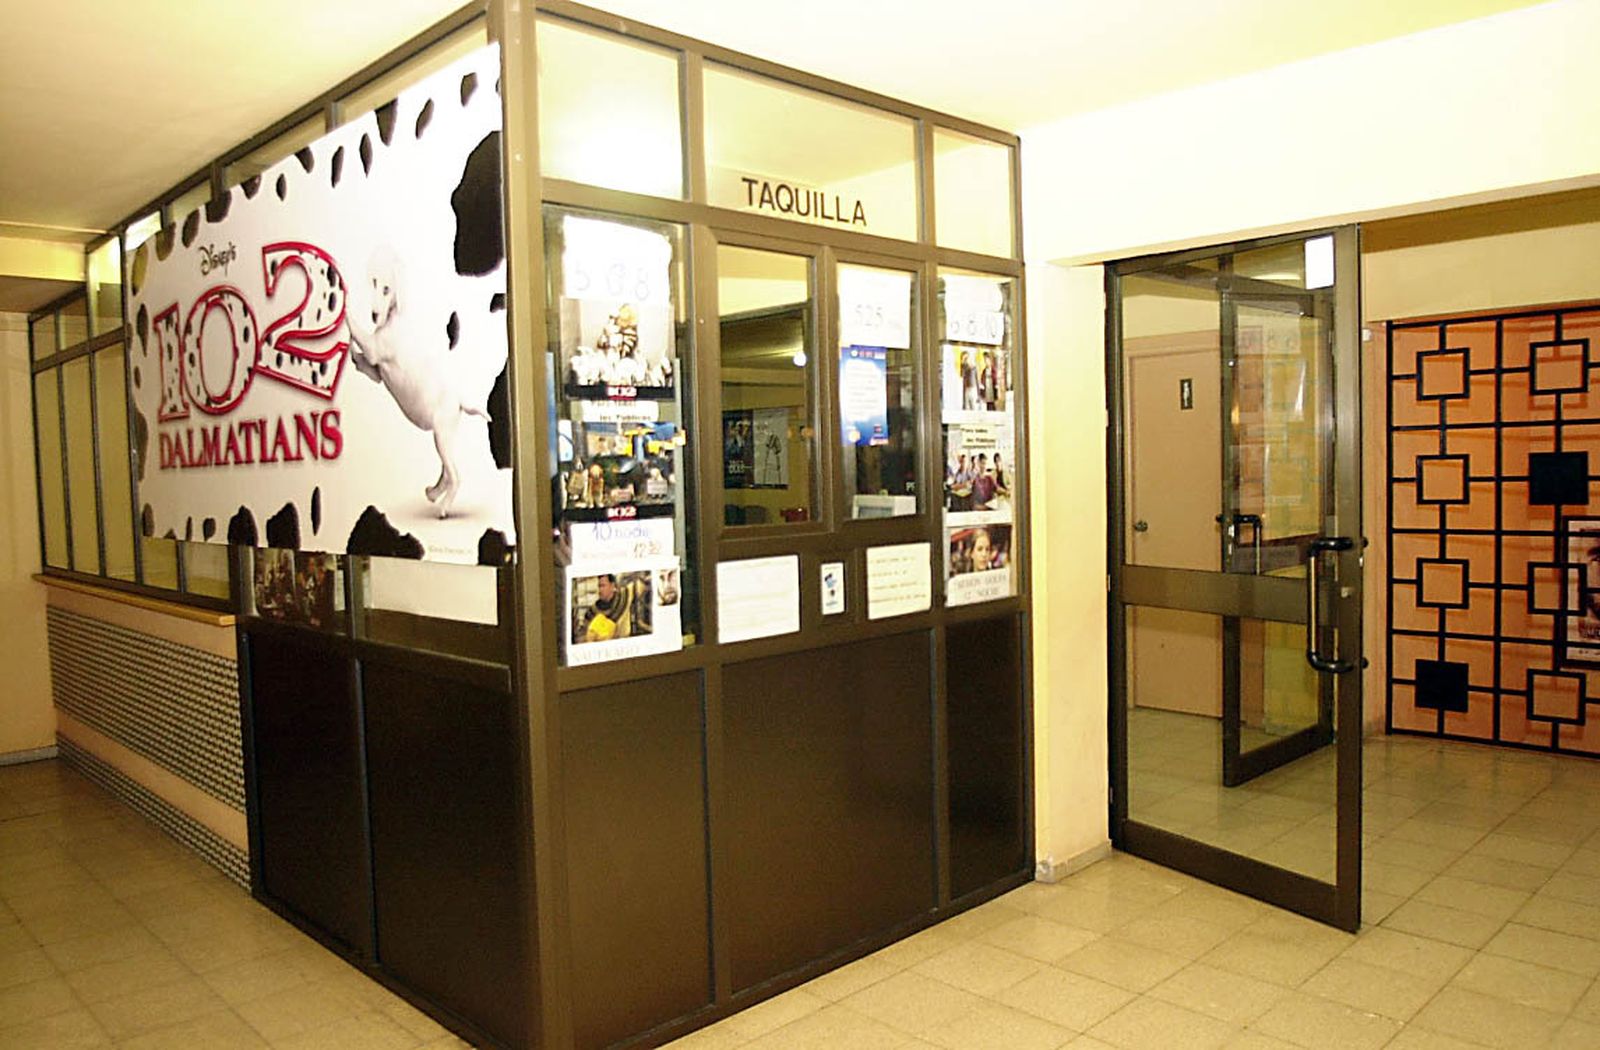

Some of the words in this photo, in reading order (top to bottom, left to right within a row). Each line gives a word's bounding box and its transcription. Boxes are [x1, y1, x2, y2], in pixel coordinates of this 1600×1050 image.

[742, 177, 867, 227] TAQUILLA
[153, 241, 350, 424] 102
[159, 410, 344, 470] DALMATIANS
